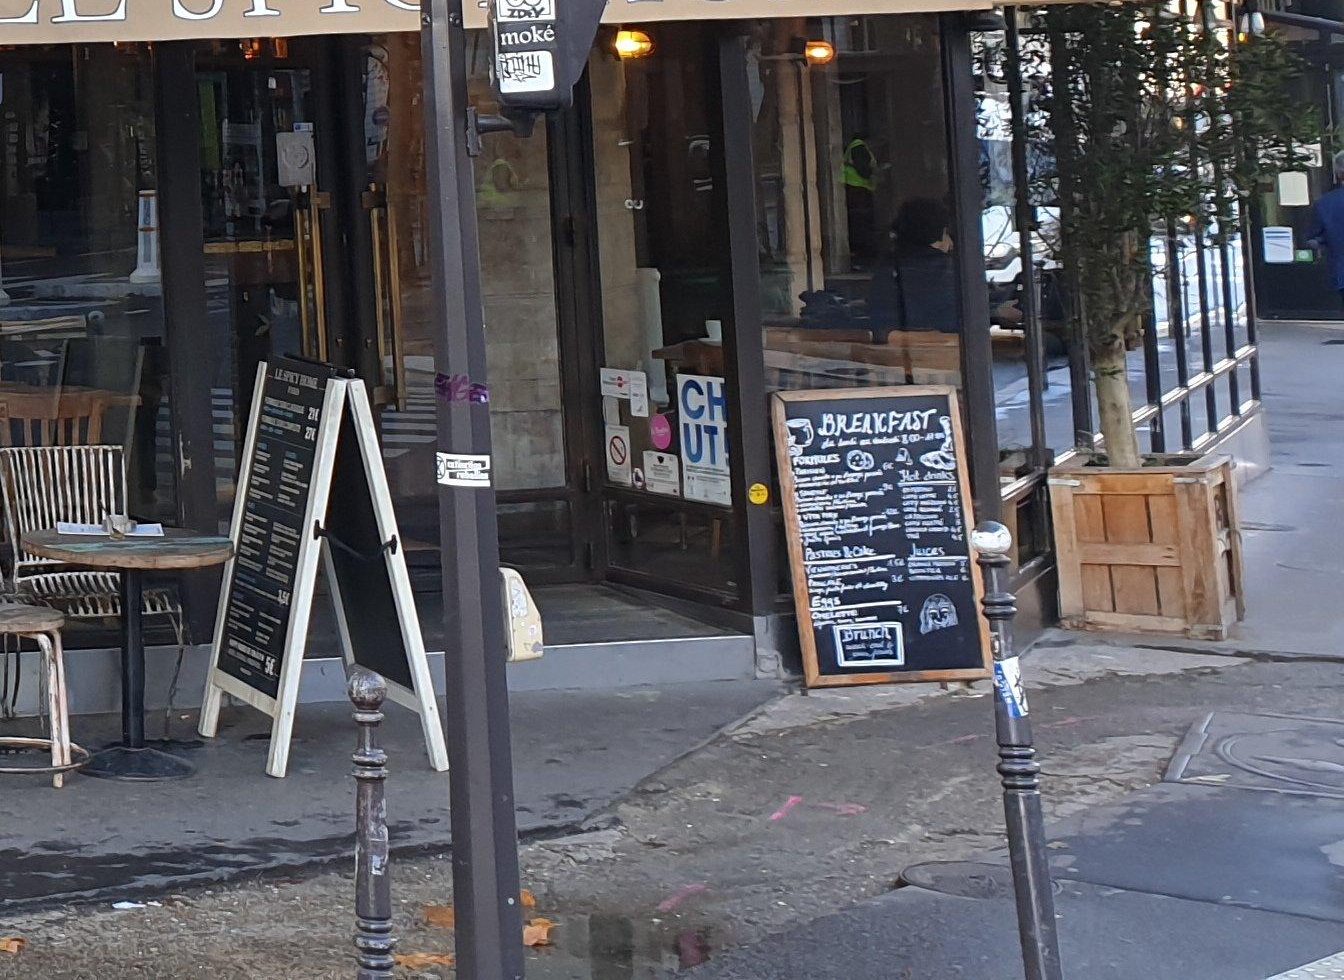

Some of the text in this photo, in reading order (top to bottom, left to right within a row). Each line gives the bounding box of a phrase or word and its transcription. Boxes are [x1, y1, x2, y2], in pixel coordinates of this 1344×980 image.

[499, 24, 556, 47] moké
[817, 408, 938, 437] BREAKFAST
[897, 469, 956, 482] Hot drinks
[811, 595, 842, 608] Eggs
[841, 624, 892, 642] Brunch
